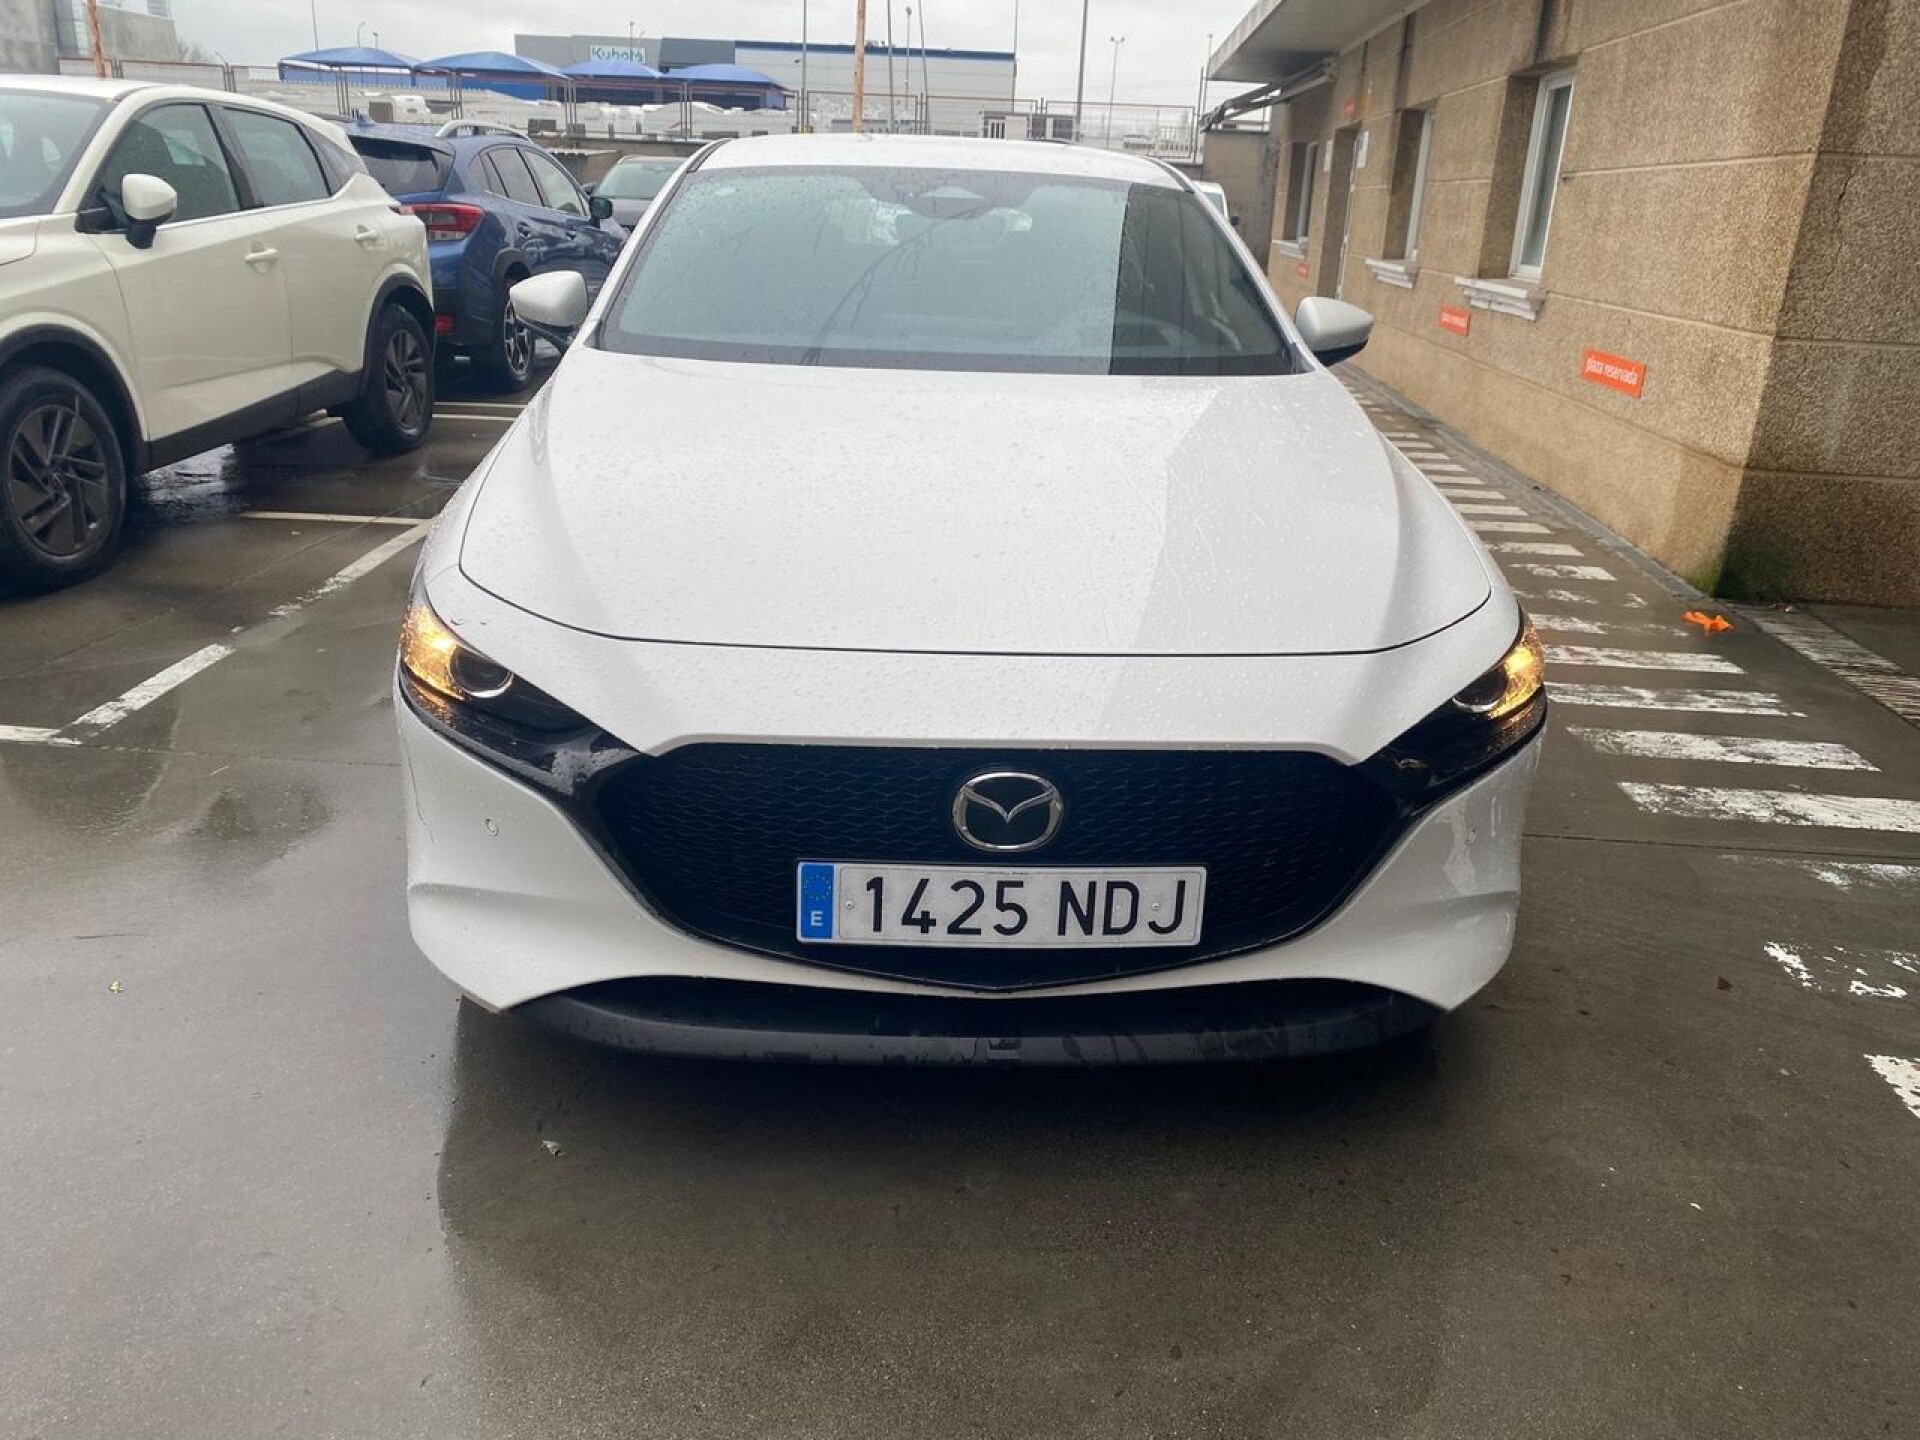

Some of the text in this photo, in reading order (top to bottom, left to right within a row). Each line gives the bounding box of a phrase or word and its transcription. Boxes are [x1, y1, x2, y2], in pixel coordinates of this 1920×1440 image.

[591, 47, 643, 62] Kubota
[865, 876, 1186, 936] 1425 NDJ
[811, 911, 823, 926] E
